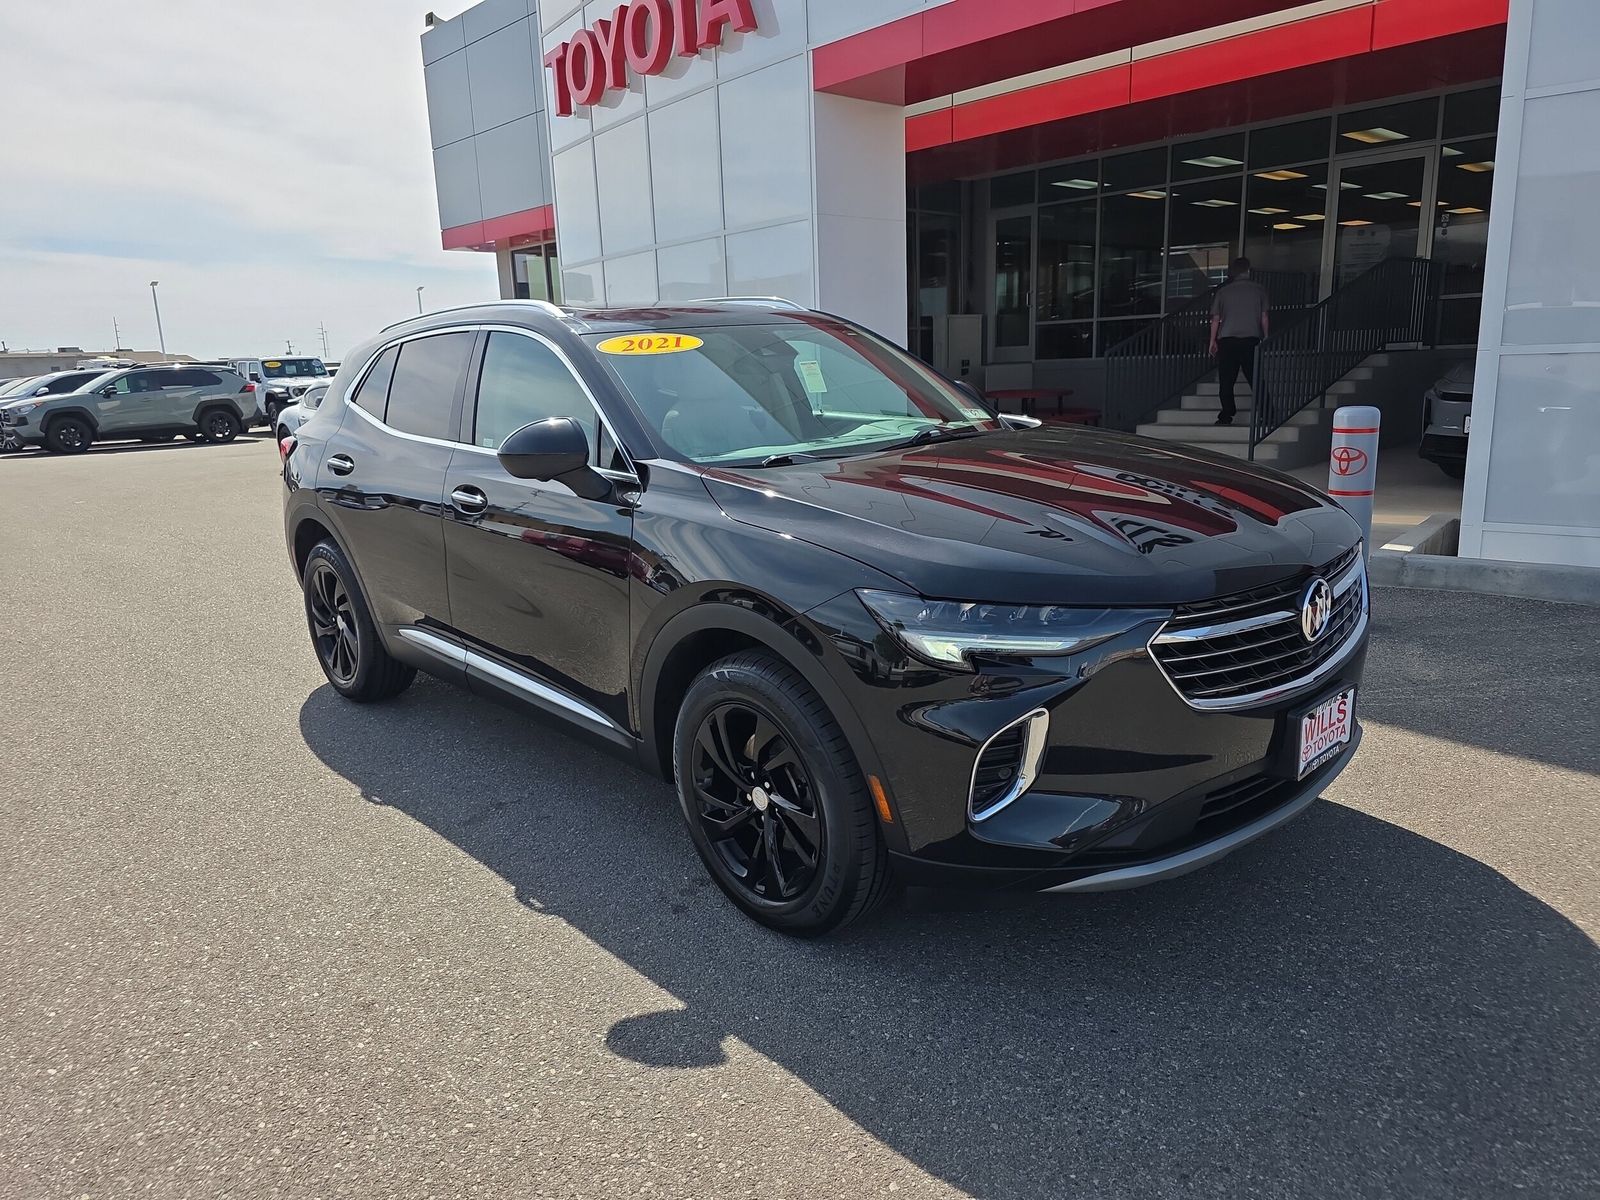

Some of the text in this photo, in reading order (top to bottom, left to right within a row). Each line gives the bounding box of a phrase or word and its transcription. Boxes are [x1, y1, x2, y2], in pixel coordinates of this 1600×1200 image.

[622, 337, 682, 352] 2021
[1305, 701, 1347, 744] WILLS
[1314, 724, 1347, 753] TOYOTA
